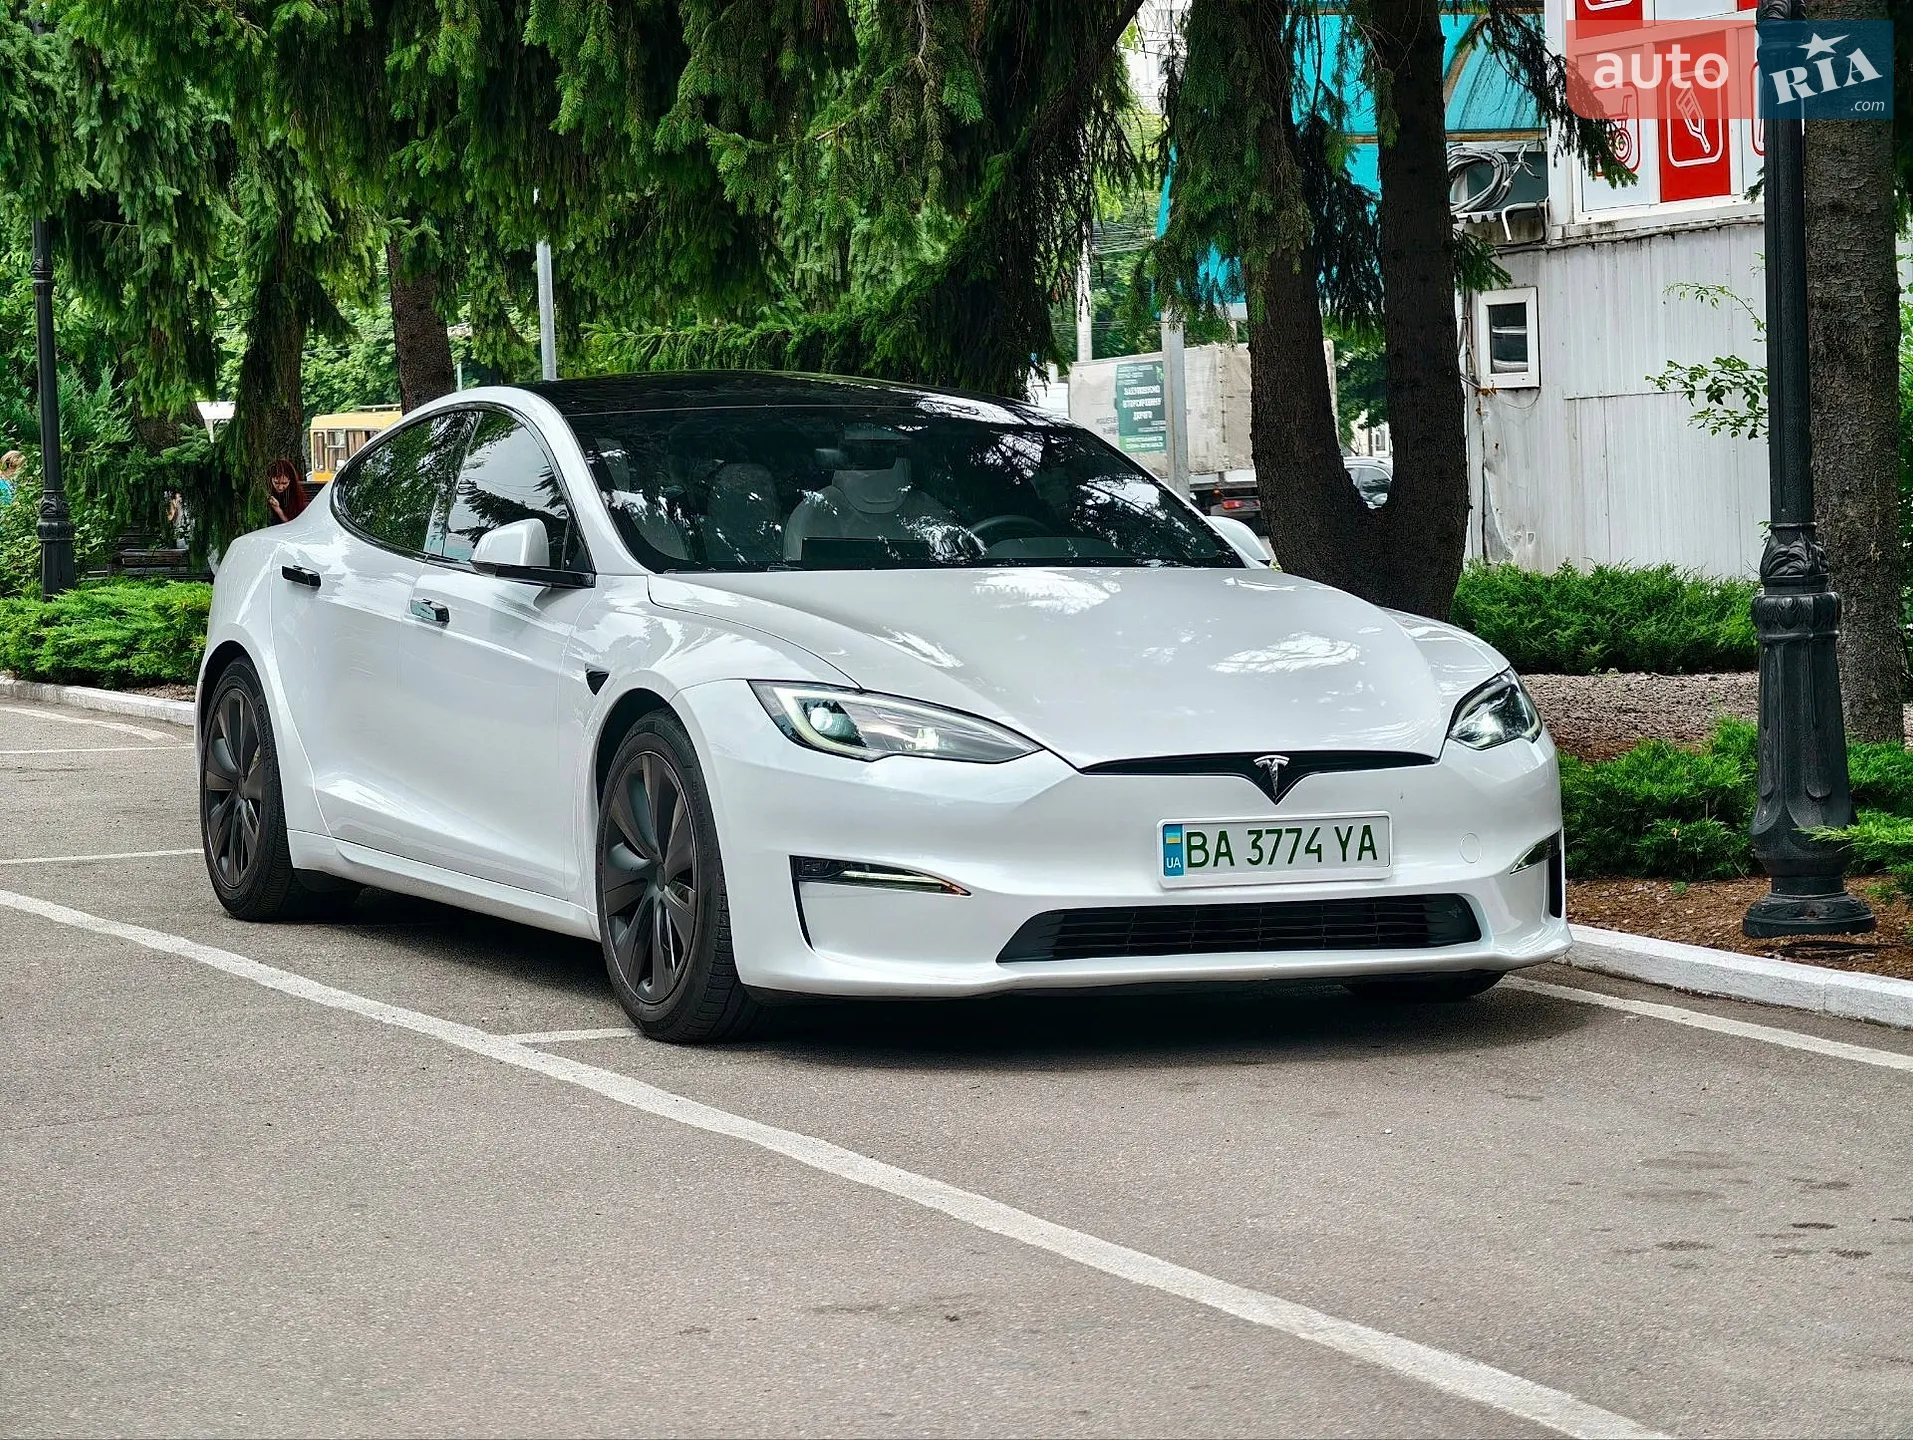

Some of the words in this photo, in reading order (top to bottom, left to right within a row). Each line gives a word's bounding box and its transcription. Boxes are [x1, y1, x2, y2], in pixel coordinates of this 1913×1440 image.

[1186, 830, 1235, 868] BA
[1246, 826, 1322, 866] 3774
[1334, 824, 1378, 862] YA
[1166, 857, 1182, 869] UA
